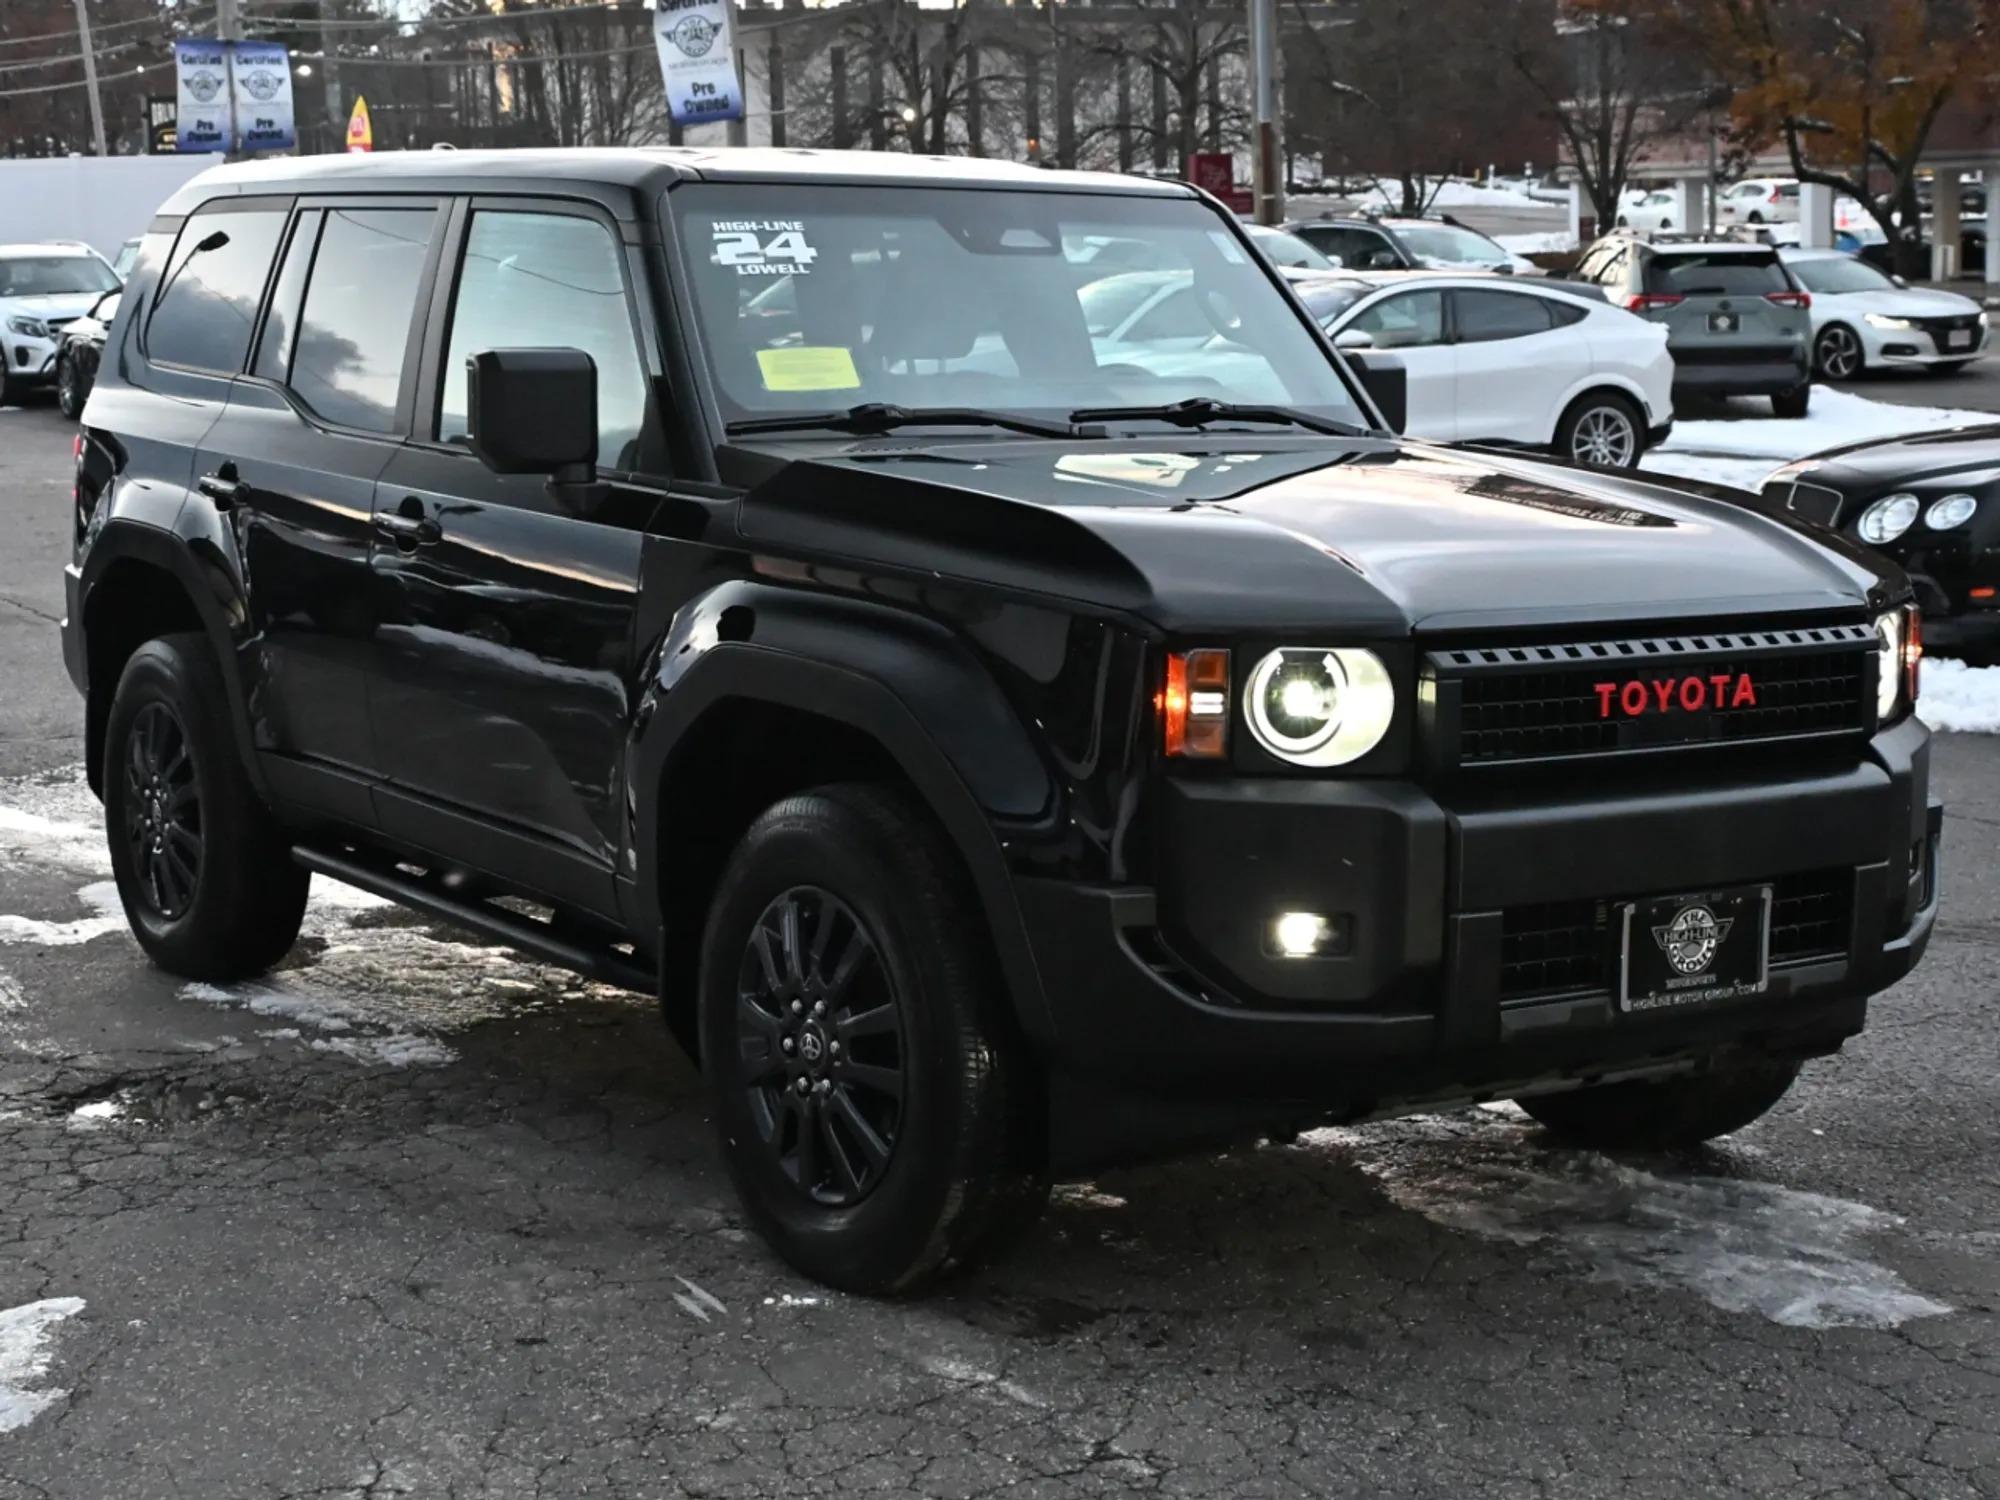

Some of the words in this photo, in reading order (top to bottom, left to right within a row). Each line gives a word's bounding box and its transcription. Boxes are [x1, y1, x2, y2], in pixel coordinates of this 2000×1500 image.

[692, 82, 716, 97] Pre
[683, 94, 730, 113] Owned
[197, 119, 214, 131] Pre
[256, 117, 274, 129] Pre
[712, 221, 805, 231] HIGH-LINE
[712, 231, 818, 265] 24
[736, 263, 810, 275] LOWELL
[1594, 673, 1757, 717] TOYOTA
[1683, 911, 1706, 925] THE
